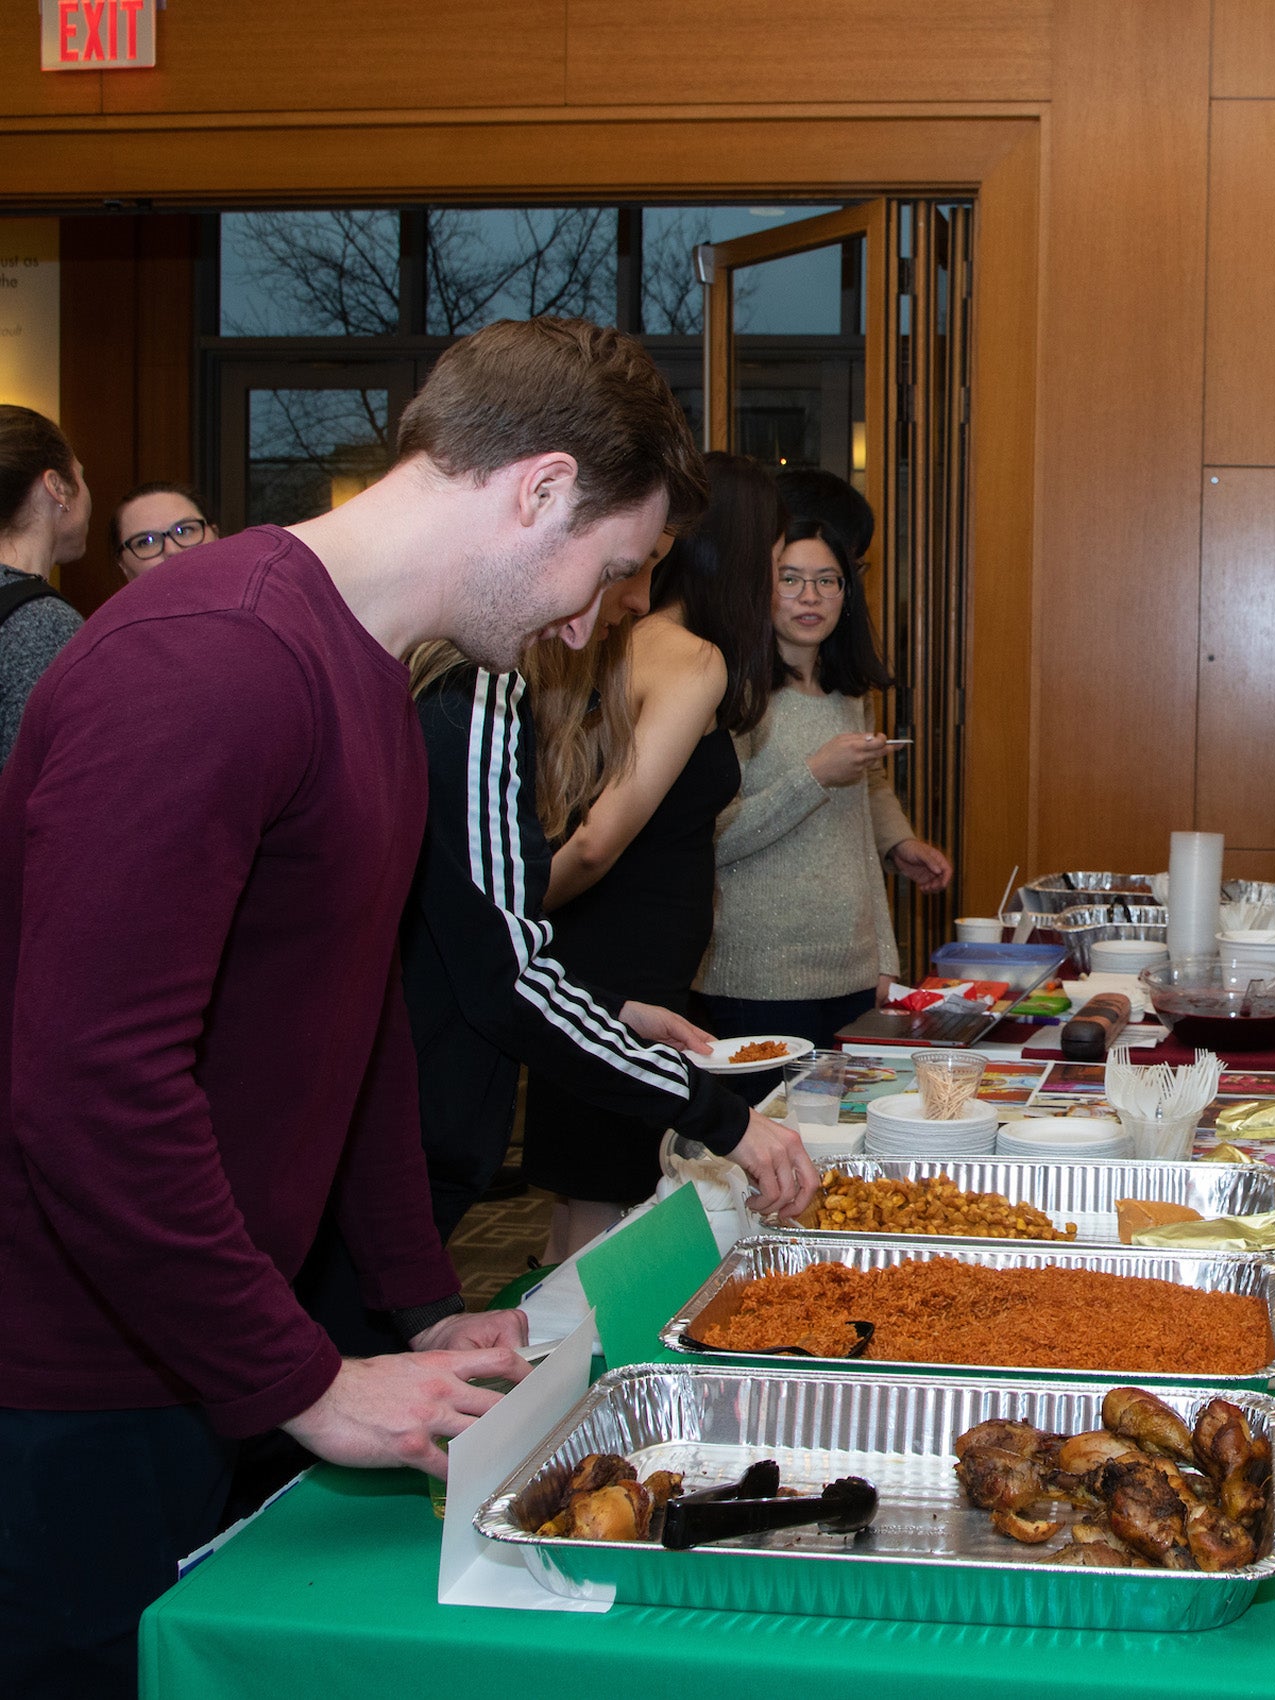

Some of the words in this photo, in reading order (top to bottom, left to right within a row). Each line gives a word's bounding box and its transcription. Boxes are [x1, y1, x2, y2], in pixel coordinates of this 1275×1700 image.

[58, 0, 144, 62] EXIT
[23, 256, 40, 268] as
[0, 273, 18, 288] he
